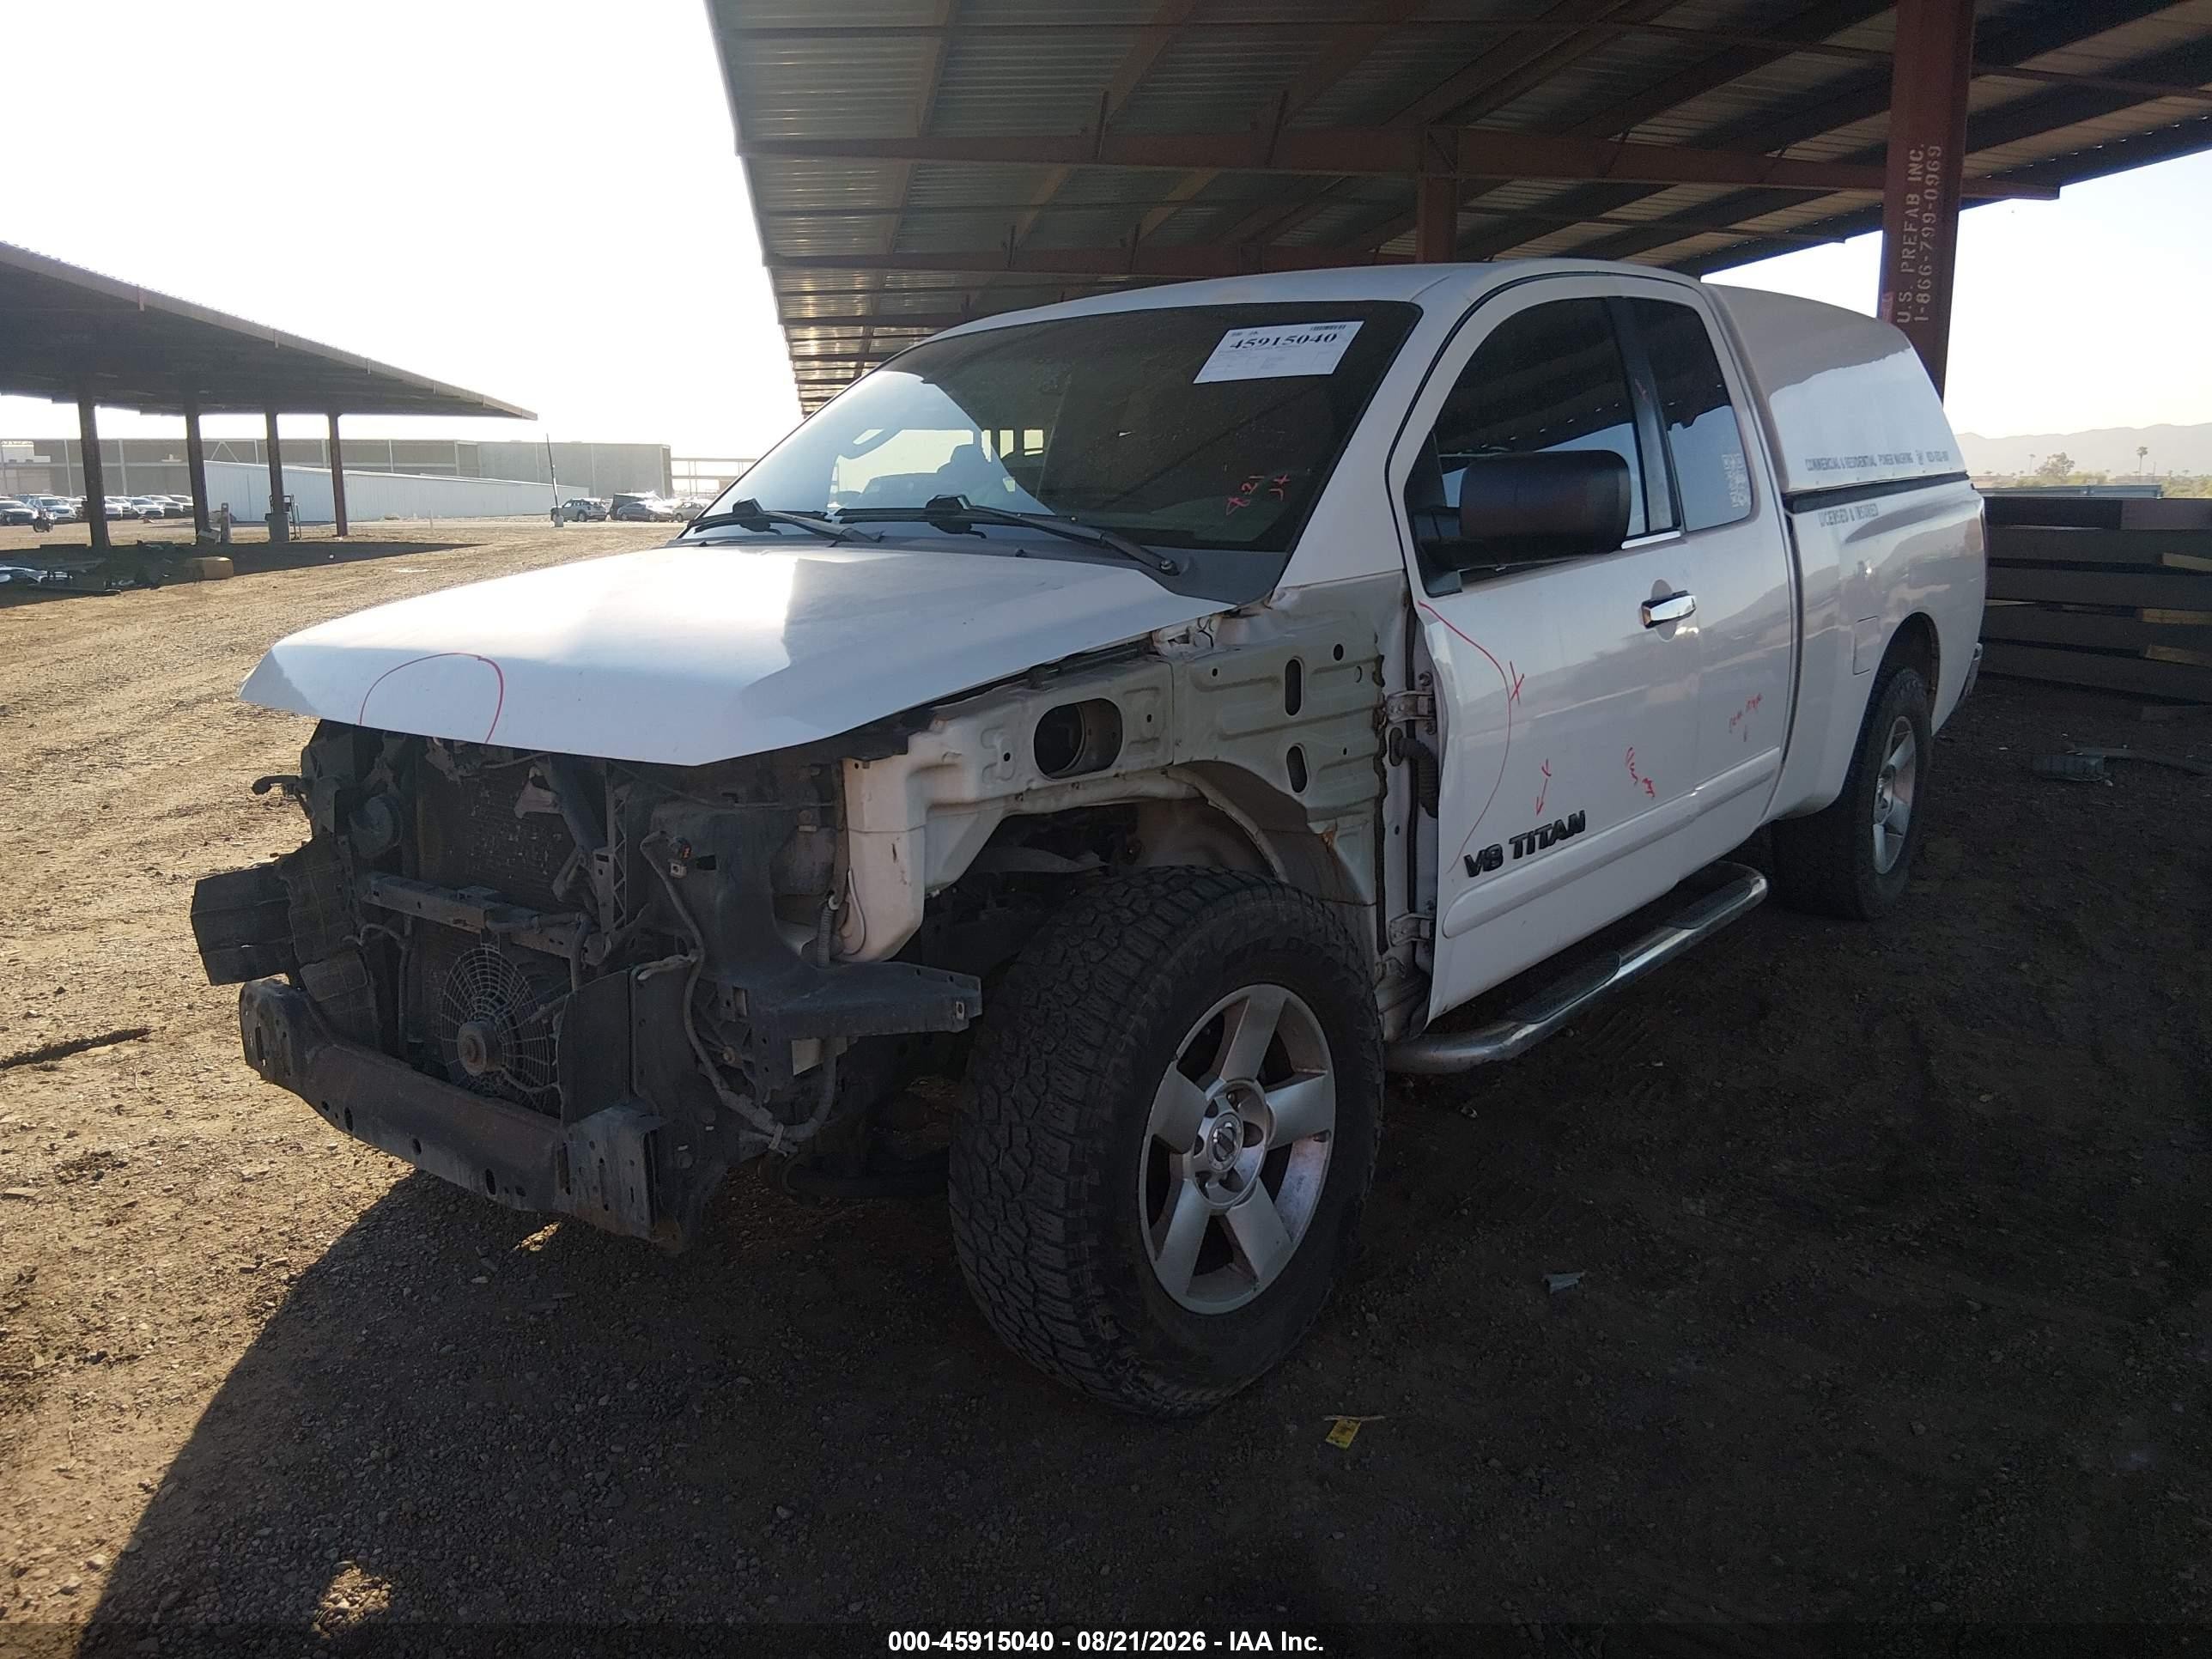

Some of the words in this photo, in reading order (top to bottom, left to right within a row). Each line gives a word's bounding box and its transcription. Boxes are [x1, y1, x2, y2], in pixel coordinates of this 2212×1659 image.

[1908, 143, 1925, 182] INC.
[1901, 193, 1920, 273] PREFAB
[1914, 145, 1942, 322] 1-866-799-0969
[1897, 286, 1914, 323] U.S.
[1229, 332, 1339, 350] 45915040
[1463, 843, 1504, 878] V8
[1509, 810, 1586, 860] TITAN
